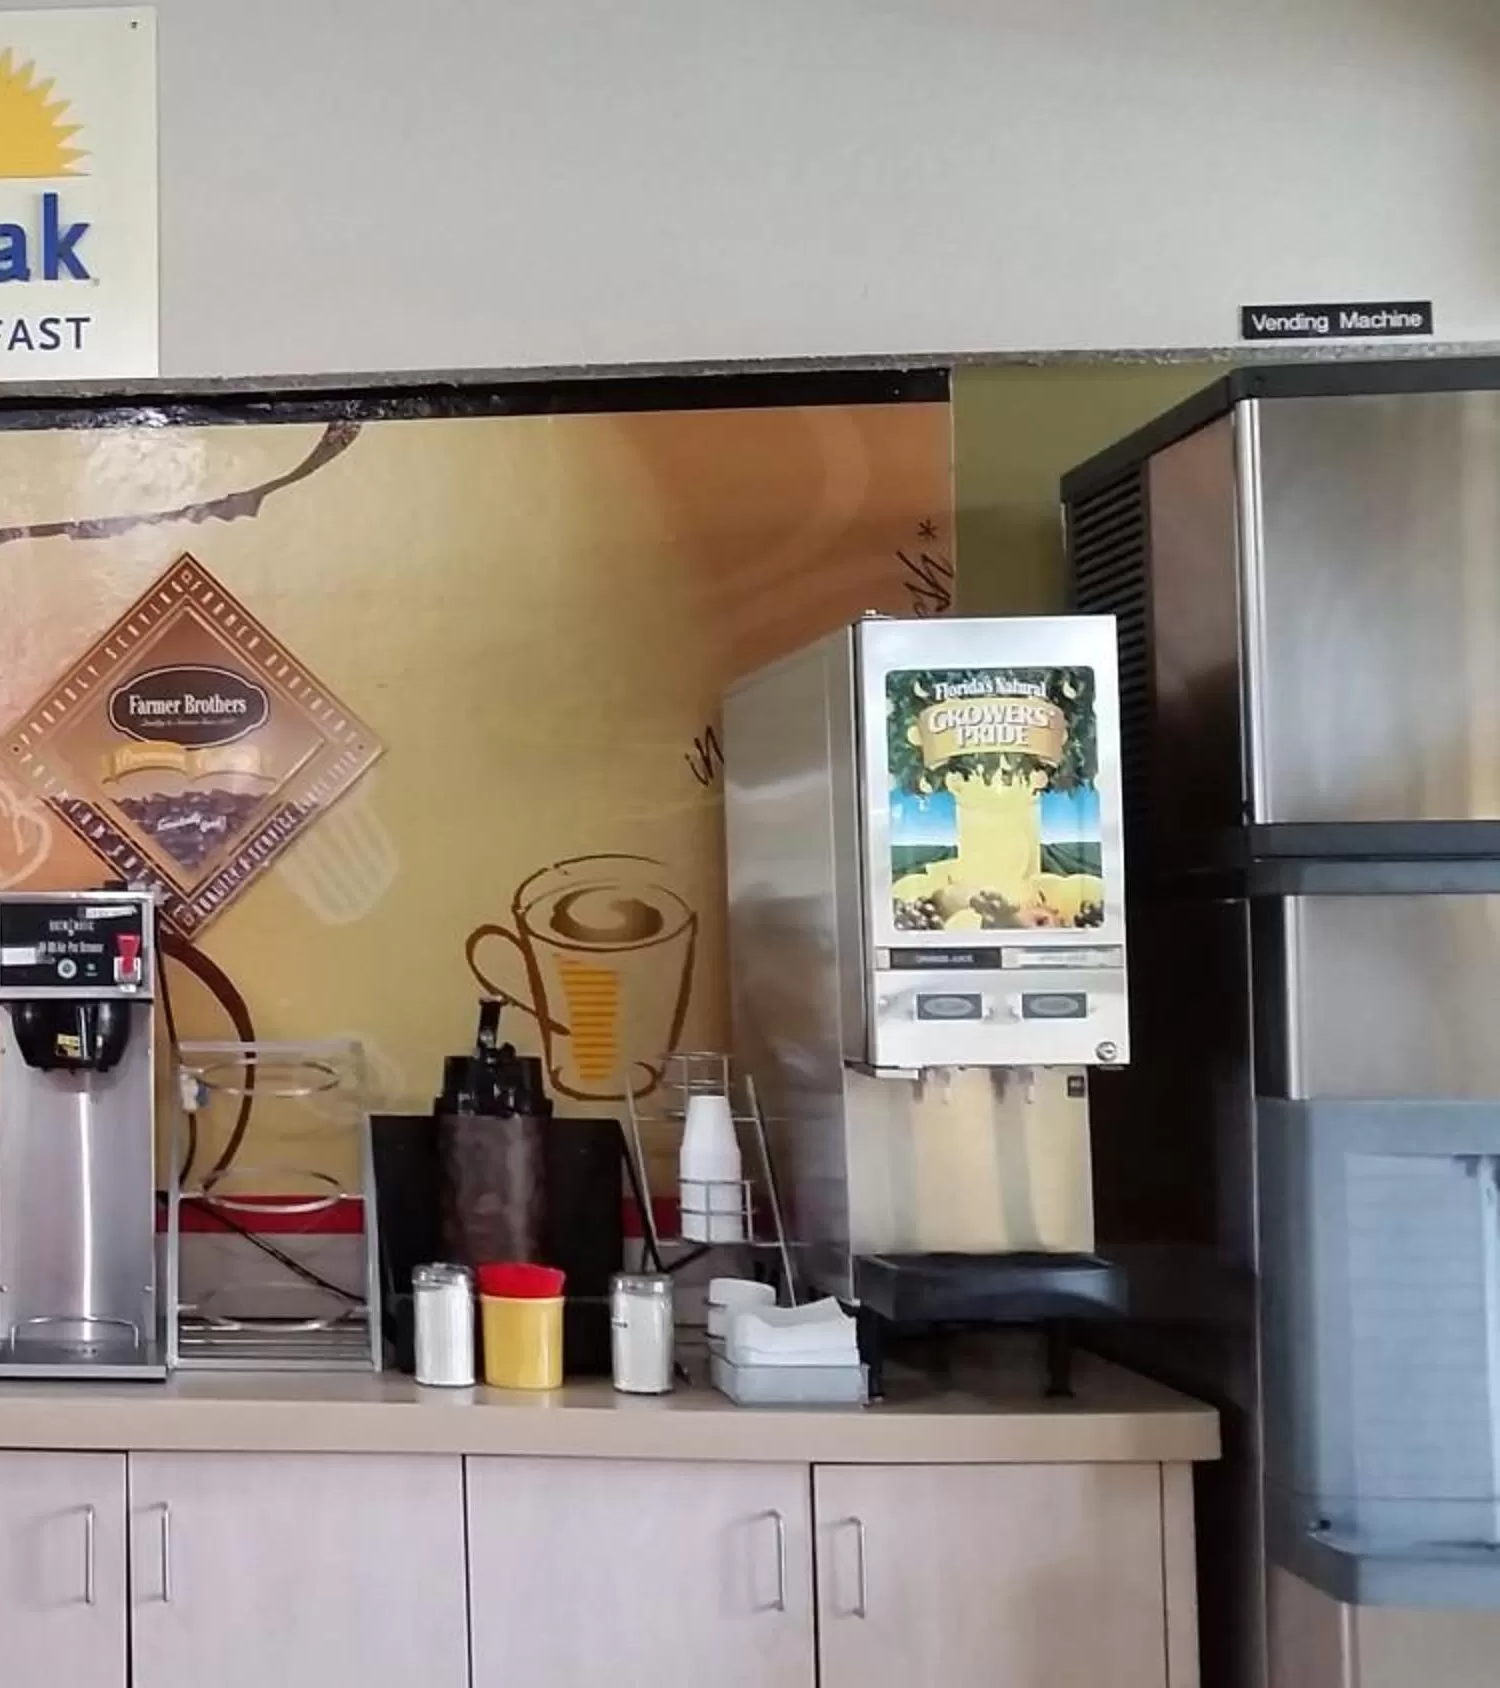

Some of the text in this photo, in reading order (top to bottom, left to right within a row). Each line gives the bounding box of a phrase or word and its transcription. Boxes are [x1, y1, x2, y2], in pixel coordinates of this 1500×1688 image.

[1251, 309, 1423, 333] Vending Machine
[934, 676, 1047, 700] Florida's Natural
[129, 692, 247, 716] Farmer Brothers
[956, 725, 1029, 748] PRIDE
